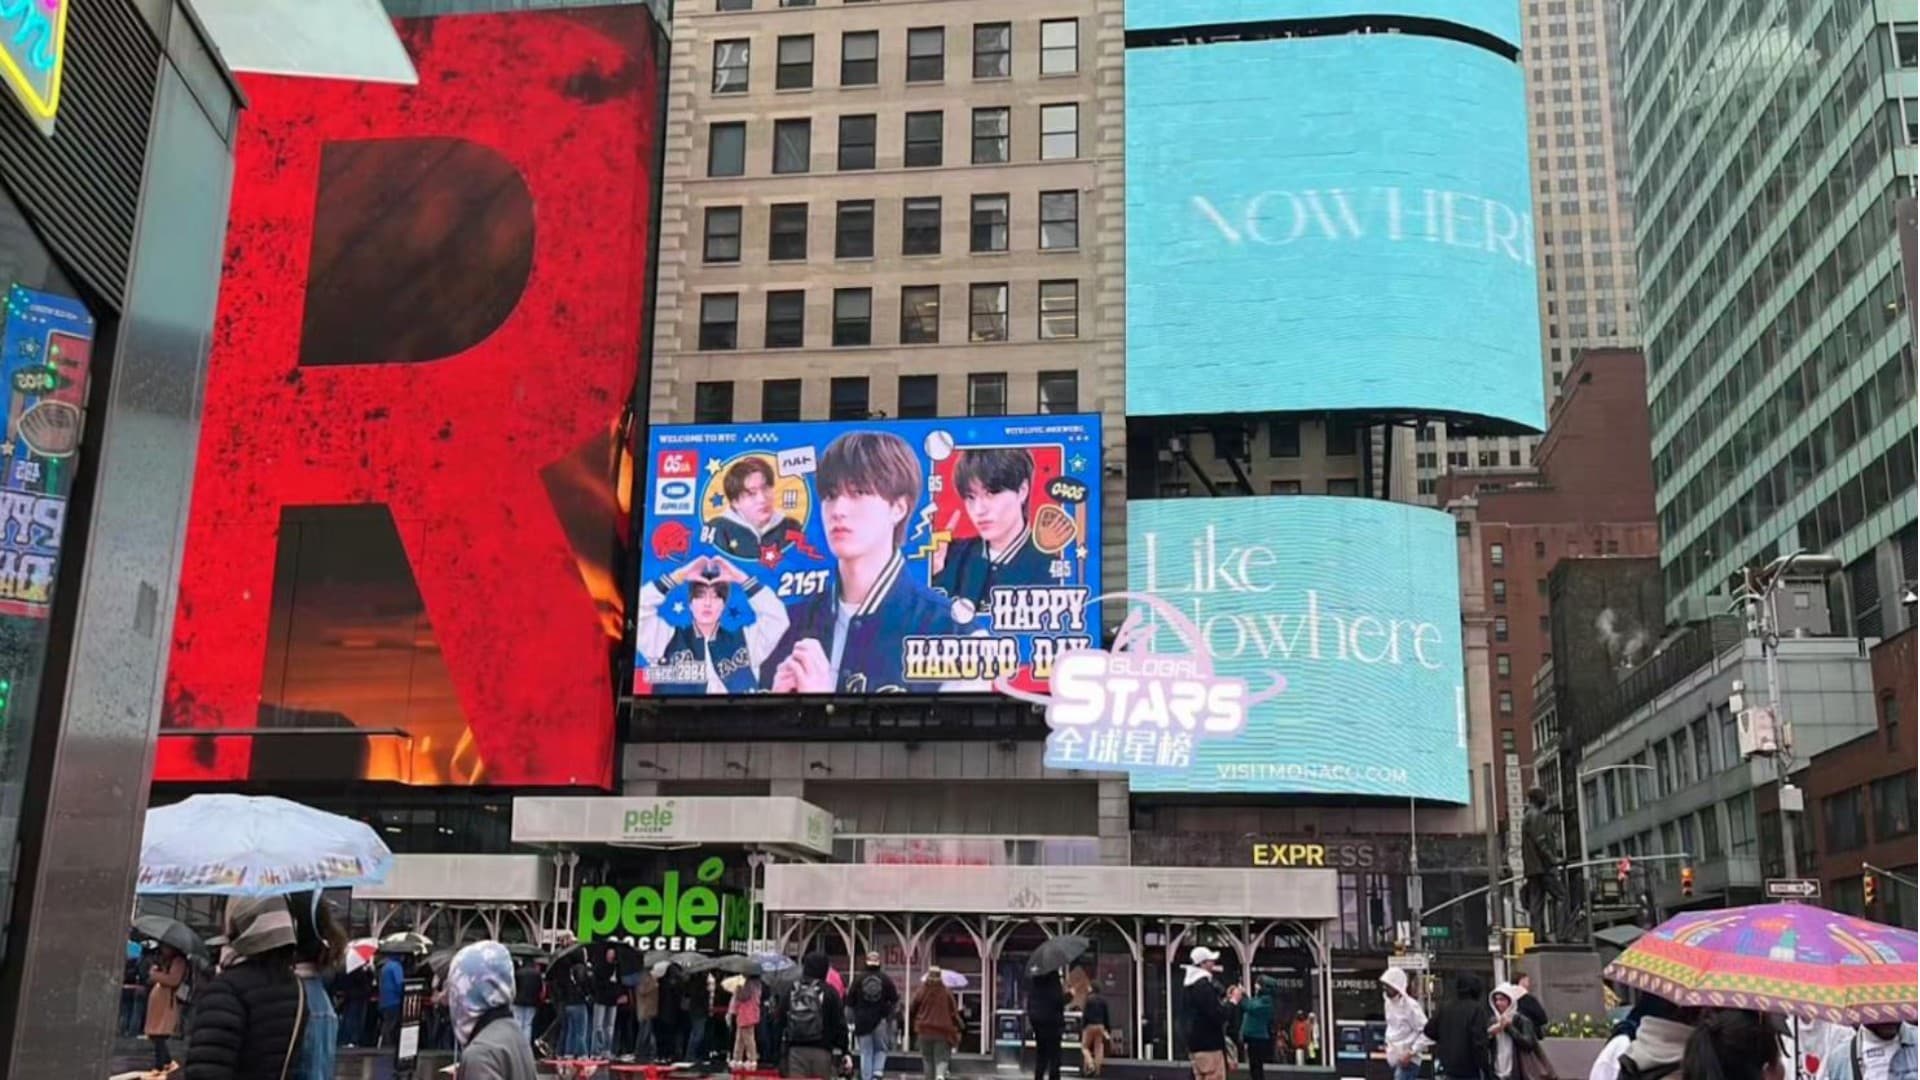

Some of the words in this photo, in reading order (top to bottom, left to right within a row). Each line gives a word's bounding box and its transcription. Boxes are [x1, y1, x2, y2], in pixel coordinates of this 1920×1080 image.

[153, 12, 648, 788] R
[659, 434, 703, 443] WELCOME
[704, 434, 718, 443] TO
[1146, 524, 1277, 593] Like
[777, 569, 830, 596] 21ST
[991, 588, 1088, 632] HAPPY
[1150, 590, 1443, 670] Nowhere
[904, 636, 1019, 681] HARUTO
[1216, 763, 1409, 785] VISITMONACO.COM
[1253, 843, 1374, 867] EXPRESS
[577, 856, 725, 944] pelé
[608, 936, 698, 950] OCCER
